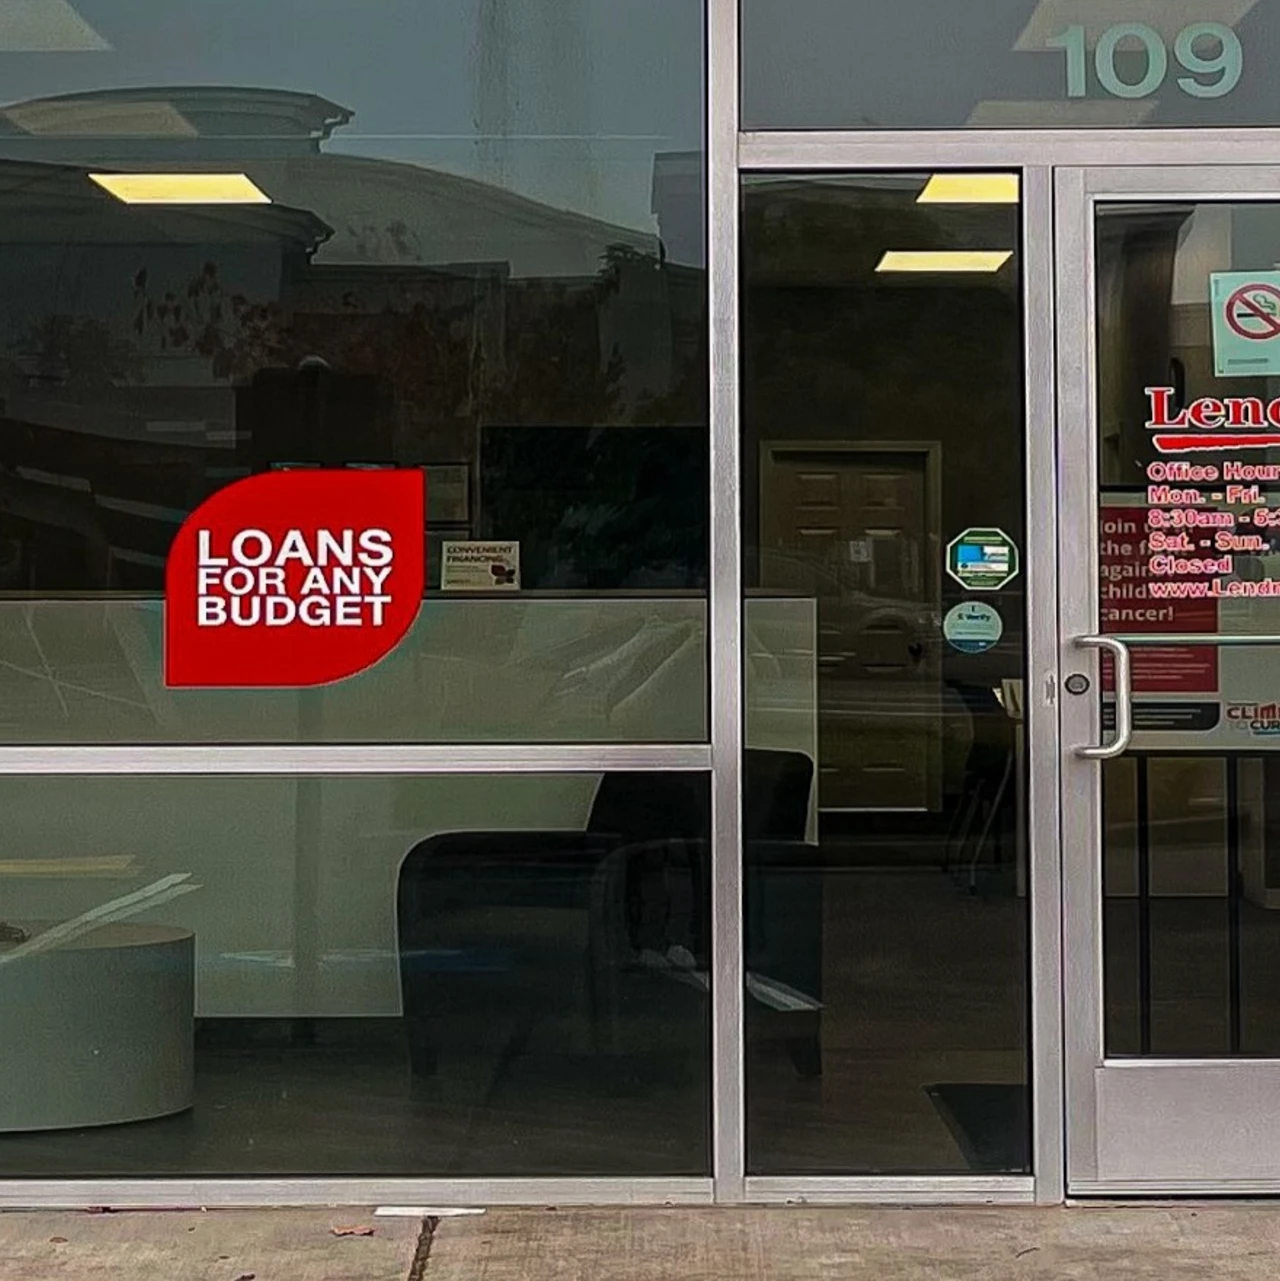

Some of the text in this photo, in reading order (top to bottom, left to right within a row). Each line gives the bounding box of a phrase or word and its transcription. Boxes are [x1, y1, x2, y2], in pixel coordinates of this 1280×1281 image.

[1046, 22, 1243, 98] 109
[1147, 461, 1219, 481] Office
[1147, 485, 1207, 504] Mon.
[1226, 485, 1266, 504] Fri.
[1148, 509, 1235, 528] 8:30am
[197, 528, 393, 568] LOANS
[1148, 531, 1196, 551] Sat.
[1215, 531, 1271, 551] Sun.
[1148, 555, 1233, 575] Closed
[197, 567, 392, 595] FOR ANY
[197, 595, 392, 627] BUDGET
